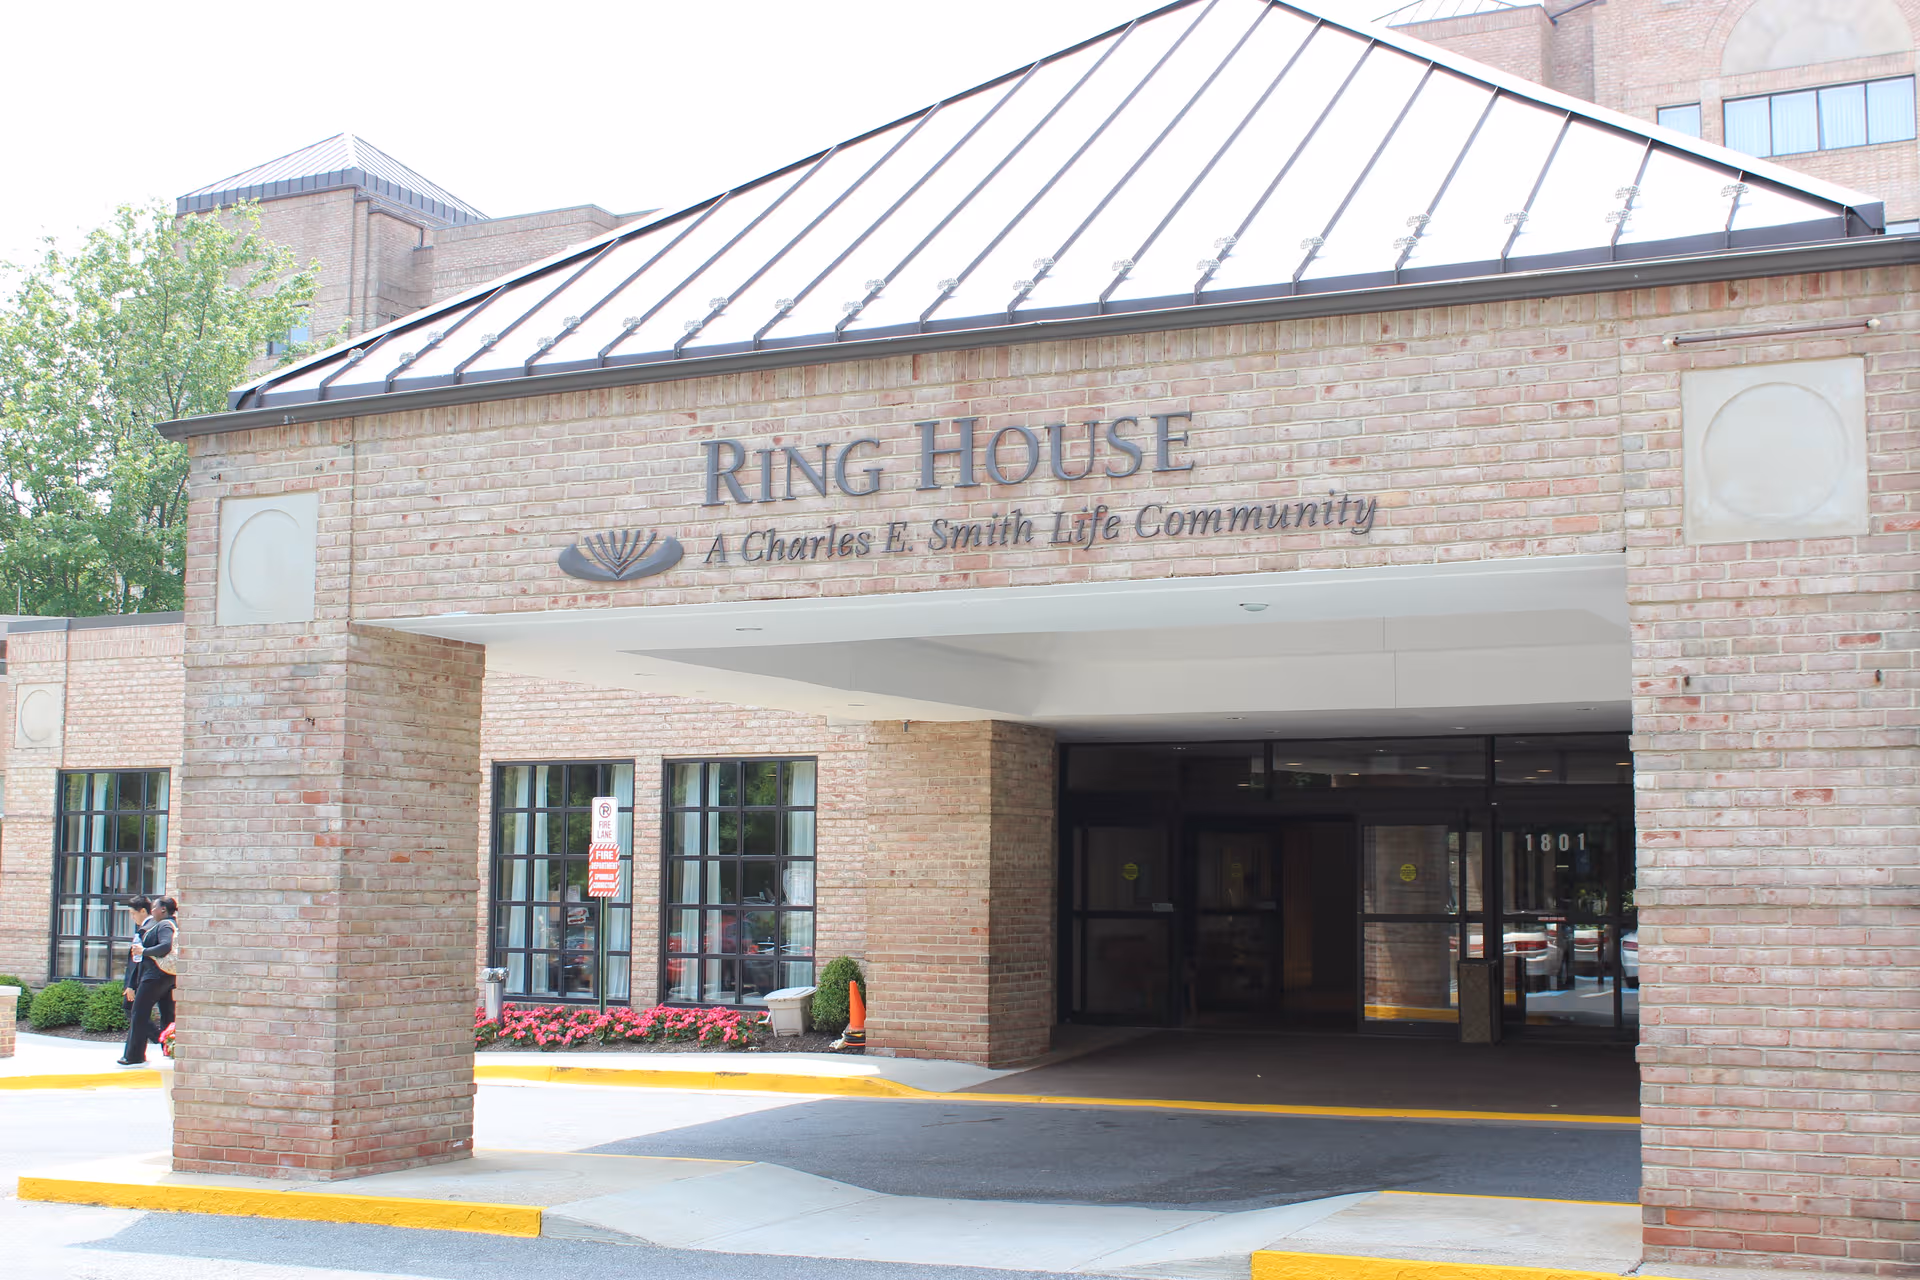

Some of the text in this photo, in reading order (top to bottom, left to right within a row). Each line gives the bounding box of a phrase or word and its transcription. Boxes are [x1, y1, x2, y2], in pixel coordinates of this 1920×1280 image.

[701, 411, 1195, 507] RING HOUSE
[703, 489, 1376, 563] A Charles E. Smith Life Community
[598, 820, 612, 830] FIRE
[597, 830, 612, 839] LANE
[1525, 832, 1585, 852] 1801
[596, 850, 614, 860] FIRE
